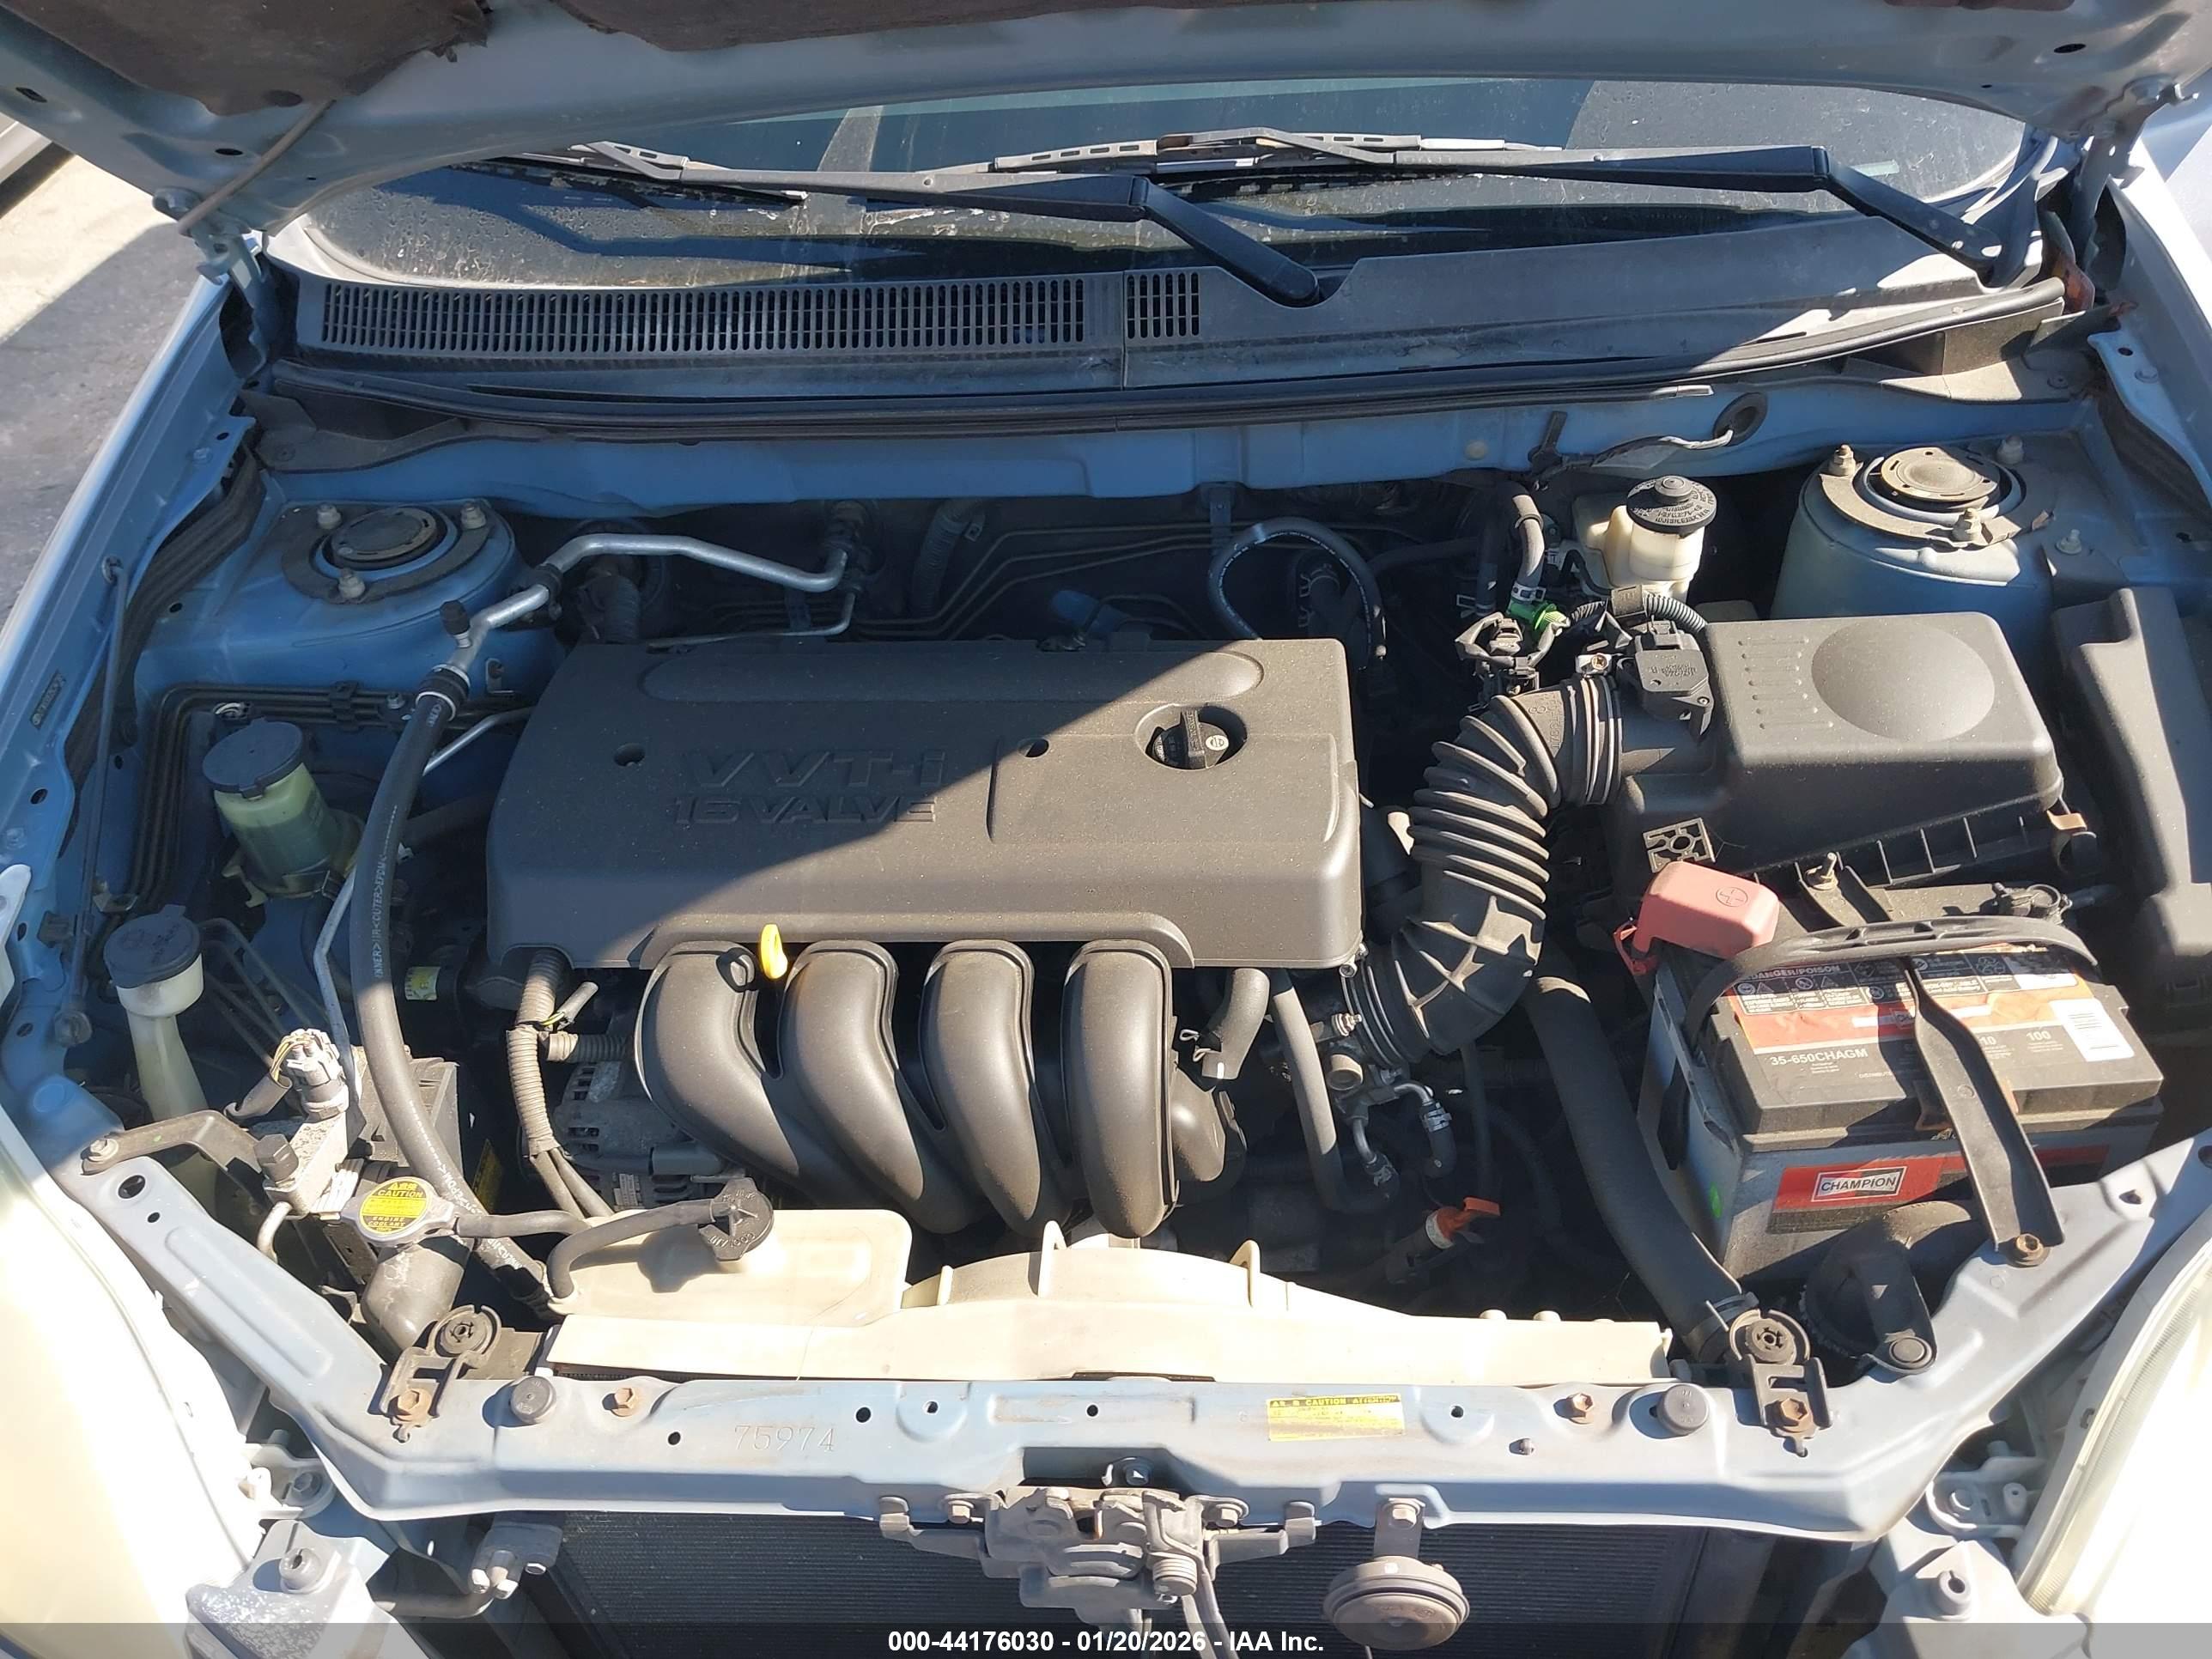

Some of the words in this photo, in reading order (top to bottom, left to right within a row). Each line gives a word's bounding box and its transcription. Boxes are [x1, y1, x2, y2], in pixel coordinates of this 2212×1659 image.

[750, 795, 938, 823] VALVE
[2026, 1030, 2051, 1042] 100
[1769, 1048, 1869, 1066] 35-650CHAGM
[1820, 1176, 1896, 1192] CHAMPION
[377, 1189, 424, 1198] CAUTION
[1305, 1397, 1346, 1407] CAUTION
[734, 1425, 836, 1452] 75974
